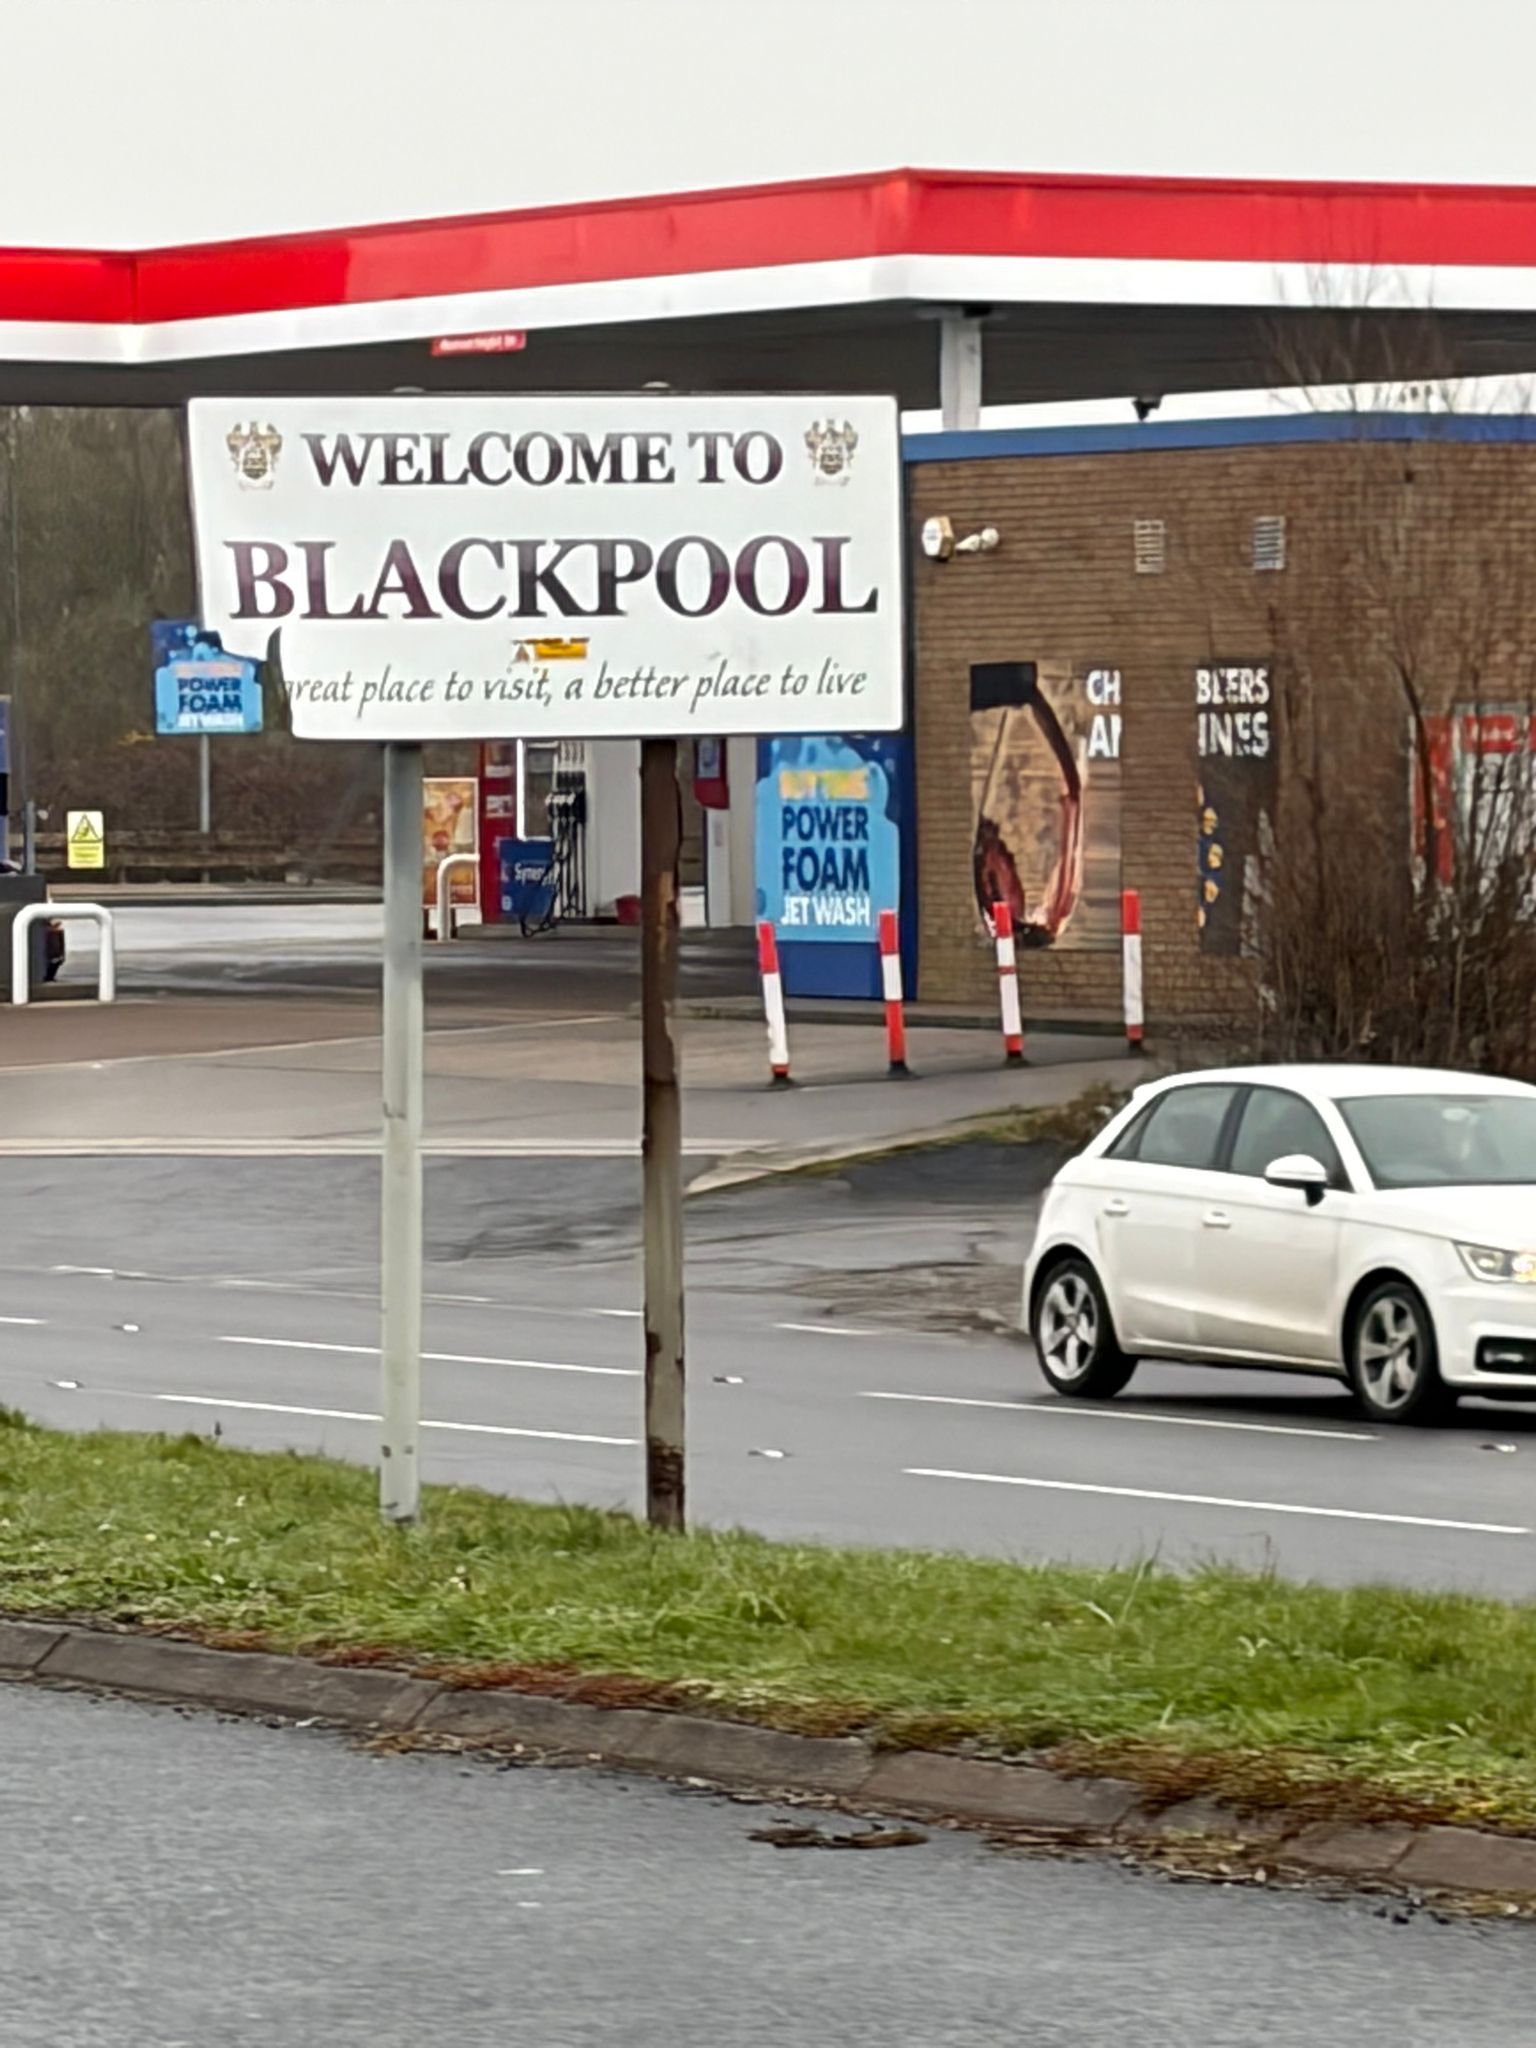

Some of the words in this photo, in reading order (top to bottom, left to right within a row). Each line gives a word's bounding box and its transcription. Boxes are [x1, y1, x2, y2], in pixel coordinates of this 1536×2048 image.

[300, 431, 675, 486] WELCOME
[688, 431, 783, 485] TO
[222, 535, 878, 619] BLACKPOOL
[177, 677, 242, 692] POWER
[357, 663, 436, 718] place
[445, 671, 474, 701] to
[484, 667, 552, 707] visit,
[564, 678, 585, 700] a
[594, 660, 690, 699] better
[689, 658, 772, 714] place
[780, 664, 809, 696] to
[817, 656, 868, 695] live
[178, 694, 243, 713] FOAM
[782, 806, 869, 841] POWER
[514, 861, 556, 887] Syner
[782, 846, 870, 892] FOAM
[780, 896, 809, 926] JET
[813, 896, 871, 927] WASH
